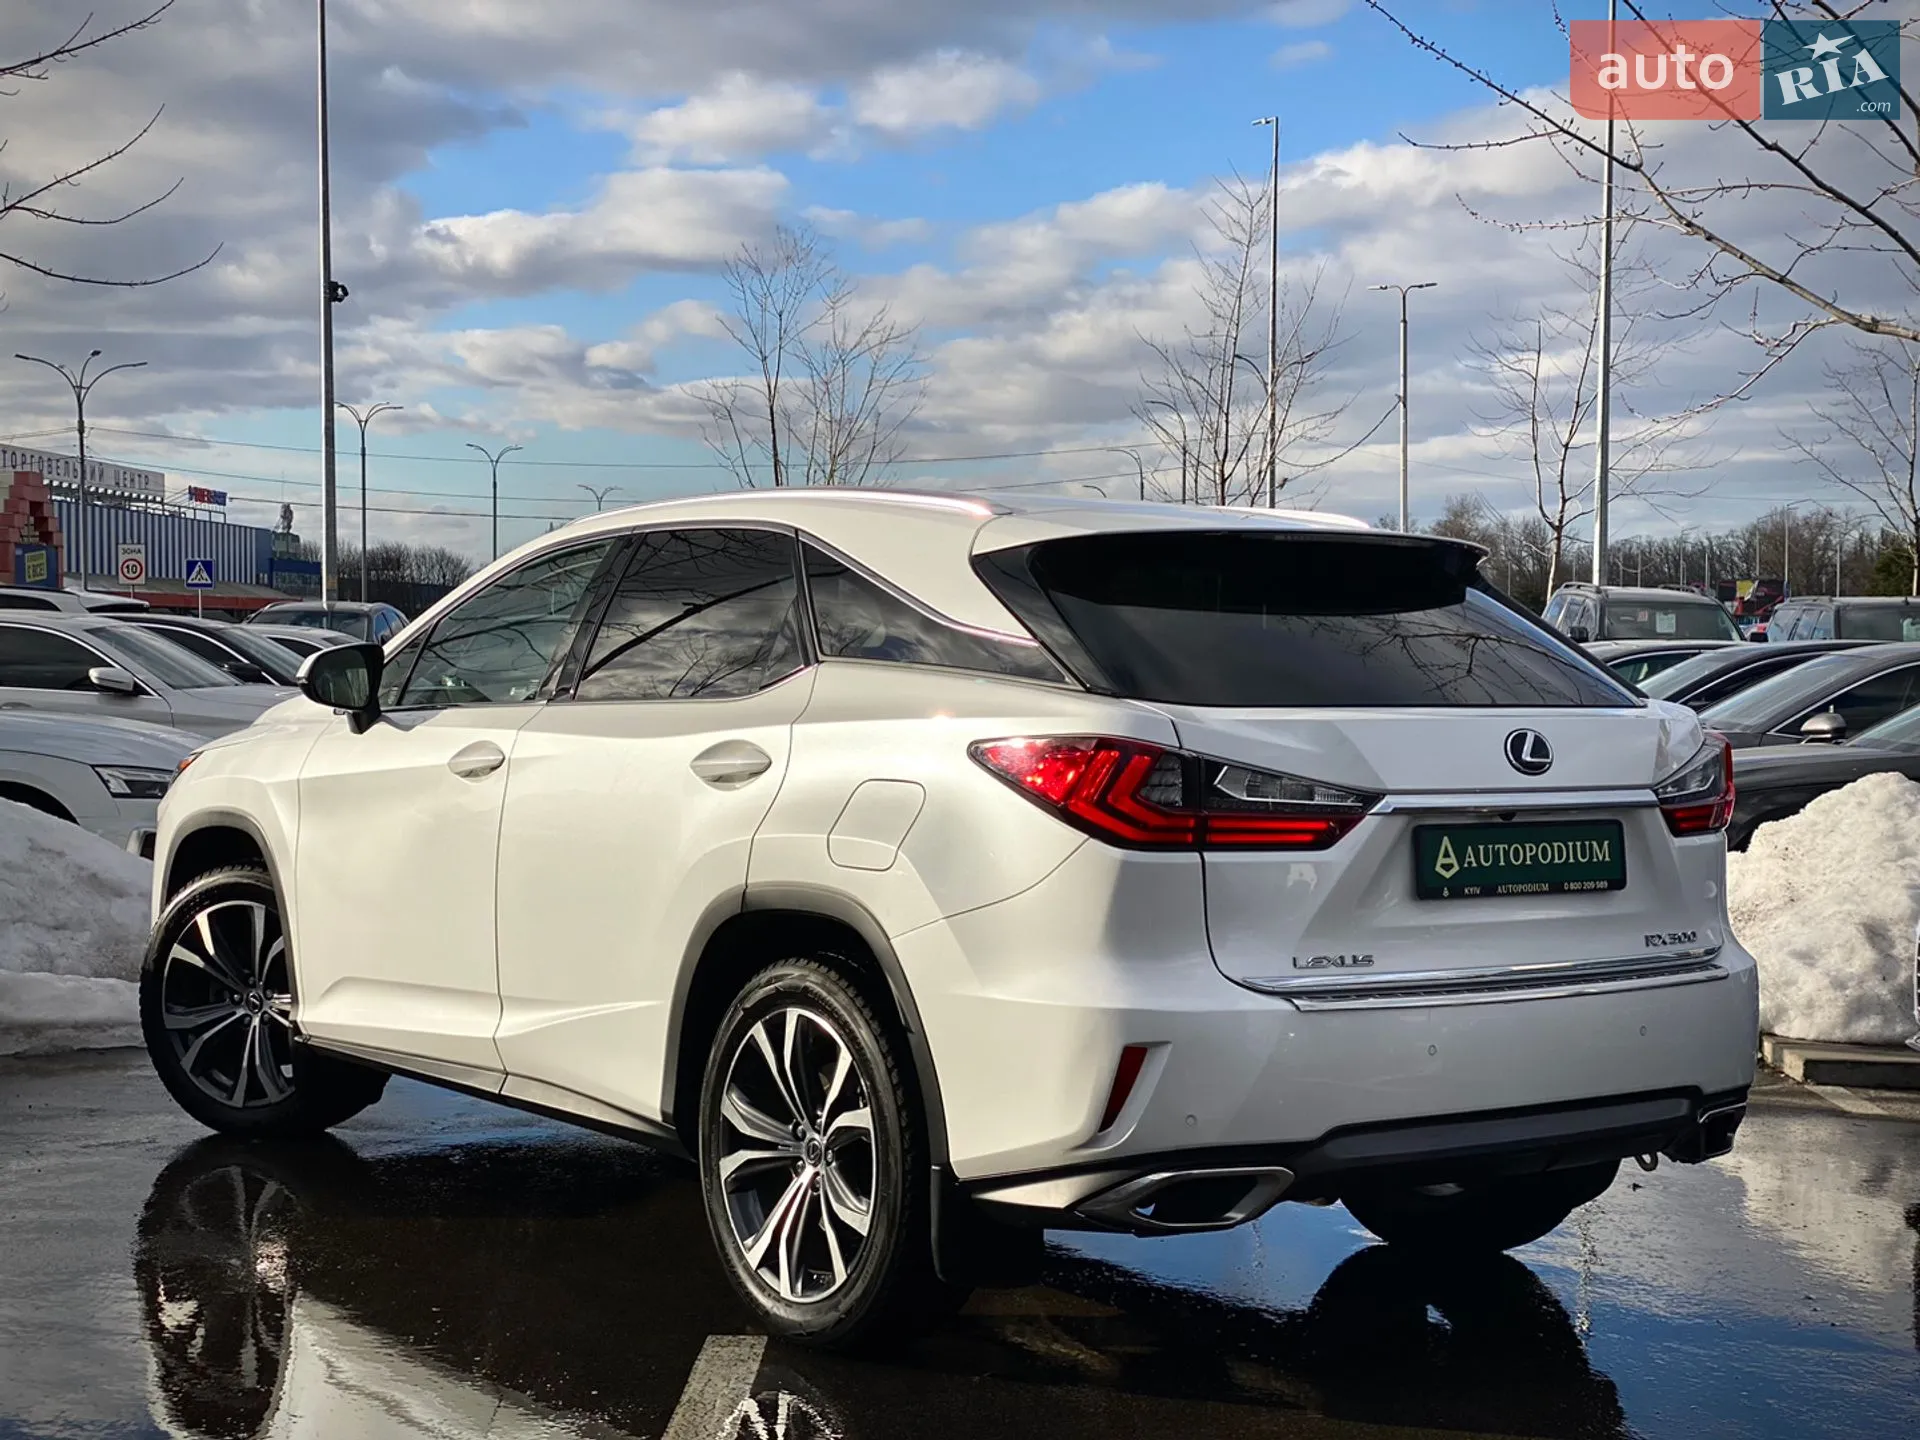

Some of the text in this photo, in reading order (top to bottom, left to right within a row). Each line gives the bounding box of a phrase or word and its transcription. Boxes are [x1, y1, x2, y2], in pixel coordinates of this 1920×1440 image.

[113, 469, 150, 490] ЦЕНТР
[121, 547, 142, 555] ЗОНА
[125, 563, 138, 575] 10
[1464, 840, 1611, 868] AUTOPODIUM
[1464, 886, 1481, 896] KYIV
[1497, 882, 1549, 894] AUTOPODIUM
[1292, 954, 1375, 970] LEXUS
